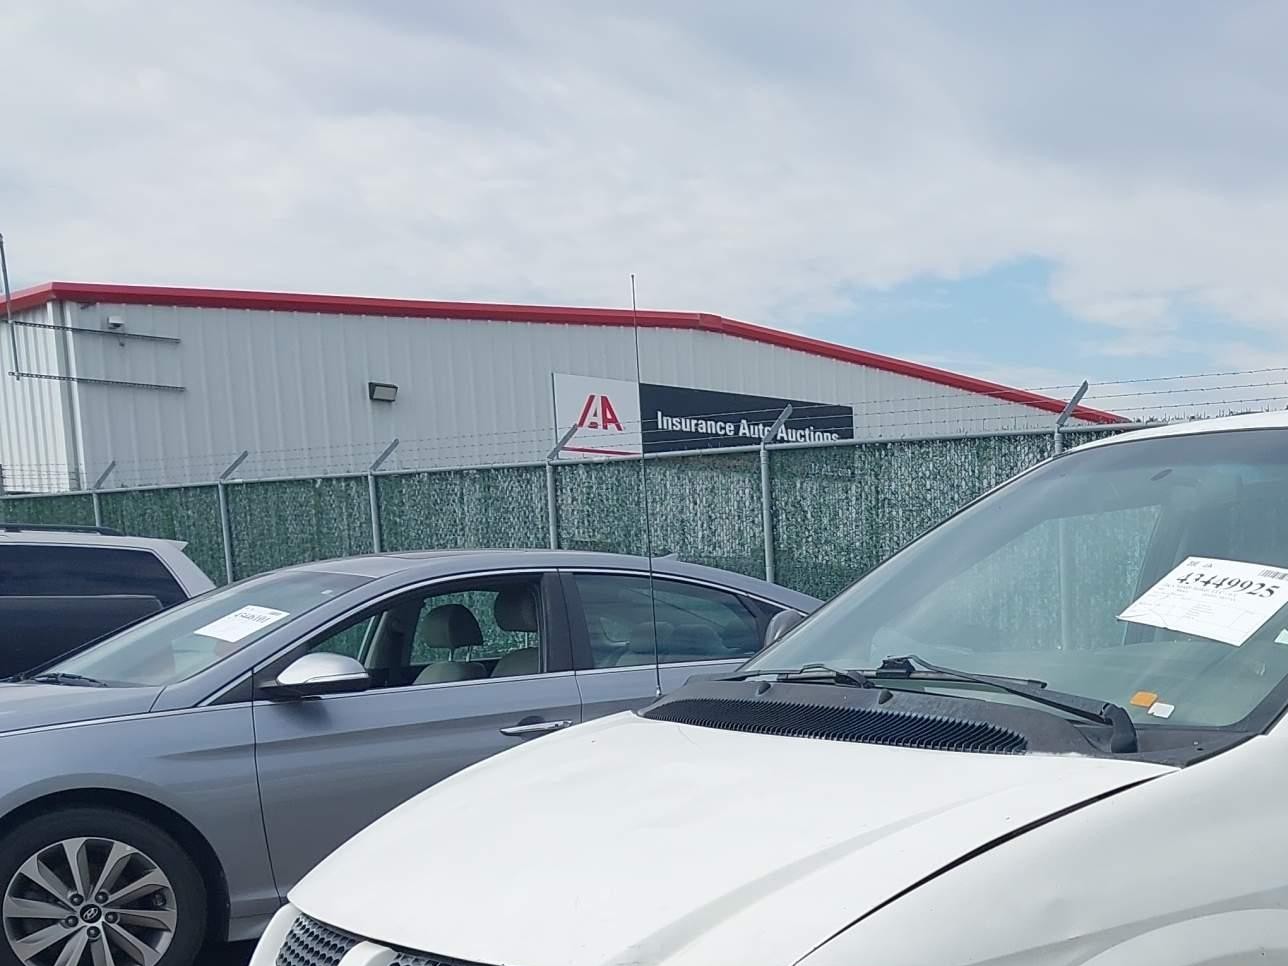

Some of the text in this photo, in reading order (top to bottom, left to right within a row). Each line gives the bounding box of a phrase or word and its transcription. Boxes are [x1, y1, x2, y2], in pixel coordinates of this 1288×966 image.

[657, 411, 735, 436] Insurance
[776, 424, 839, 442] Auctions
[1176, 571, 1281, 599] 43449925
